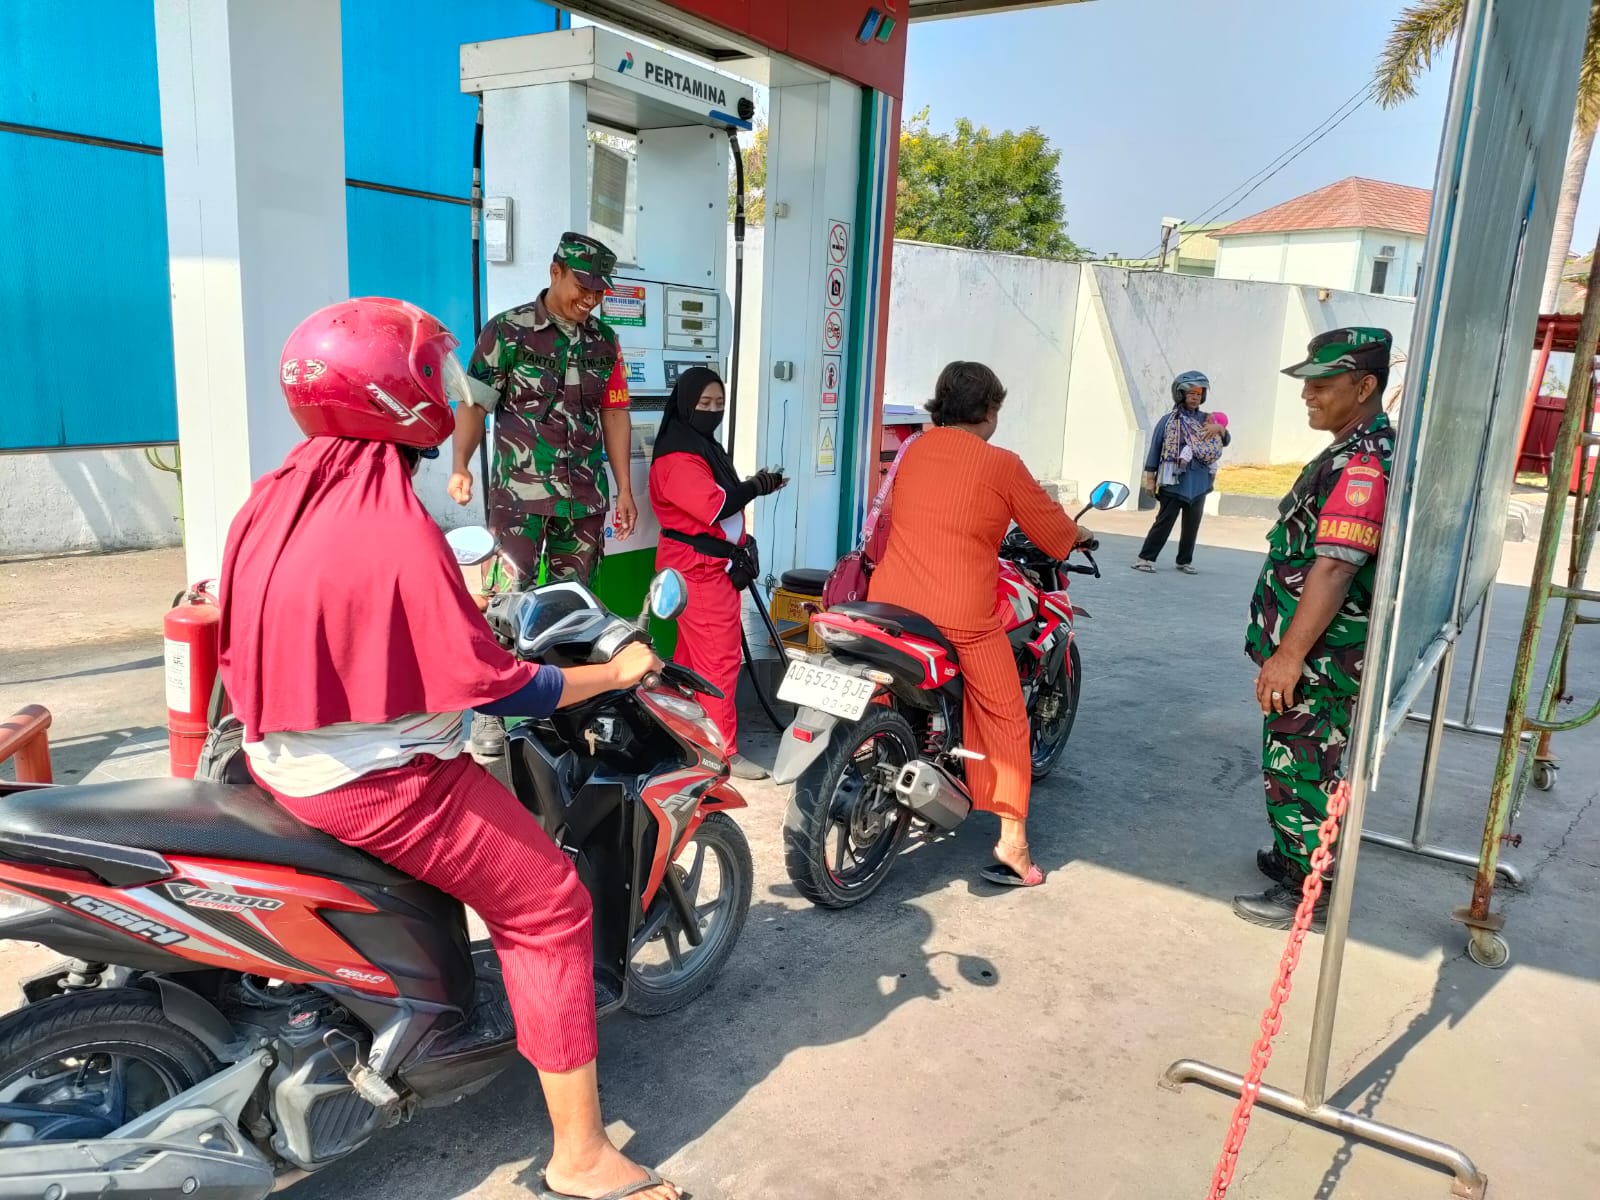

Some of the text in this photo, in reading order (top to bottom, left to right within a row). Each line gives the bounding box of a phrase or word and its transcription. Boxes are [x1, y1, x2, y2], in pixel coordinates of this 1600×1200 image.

[644, 61, 727, 107] PERTAMINA
[521, 350, 556, 370] YANTO
[1318, 519, 1380, 549] BABINSA
[786, 664, 872, 700] AD 6525 BJE
[701, 758, 721, 772] HONDA
[165, 883, 284, 911] VARIO
